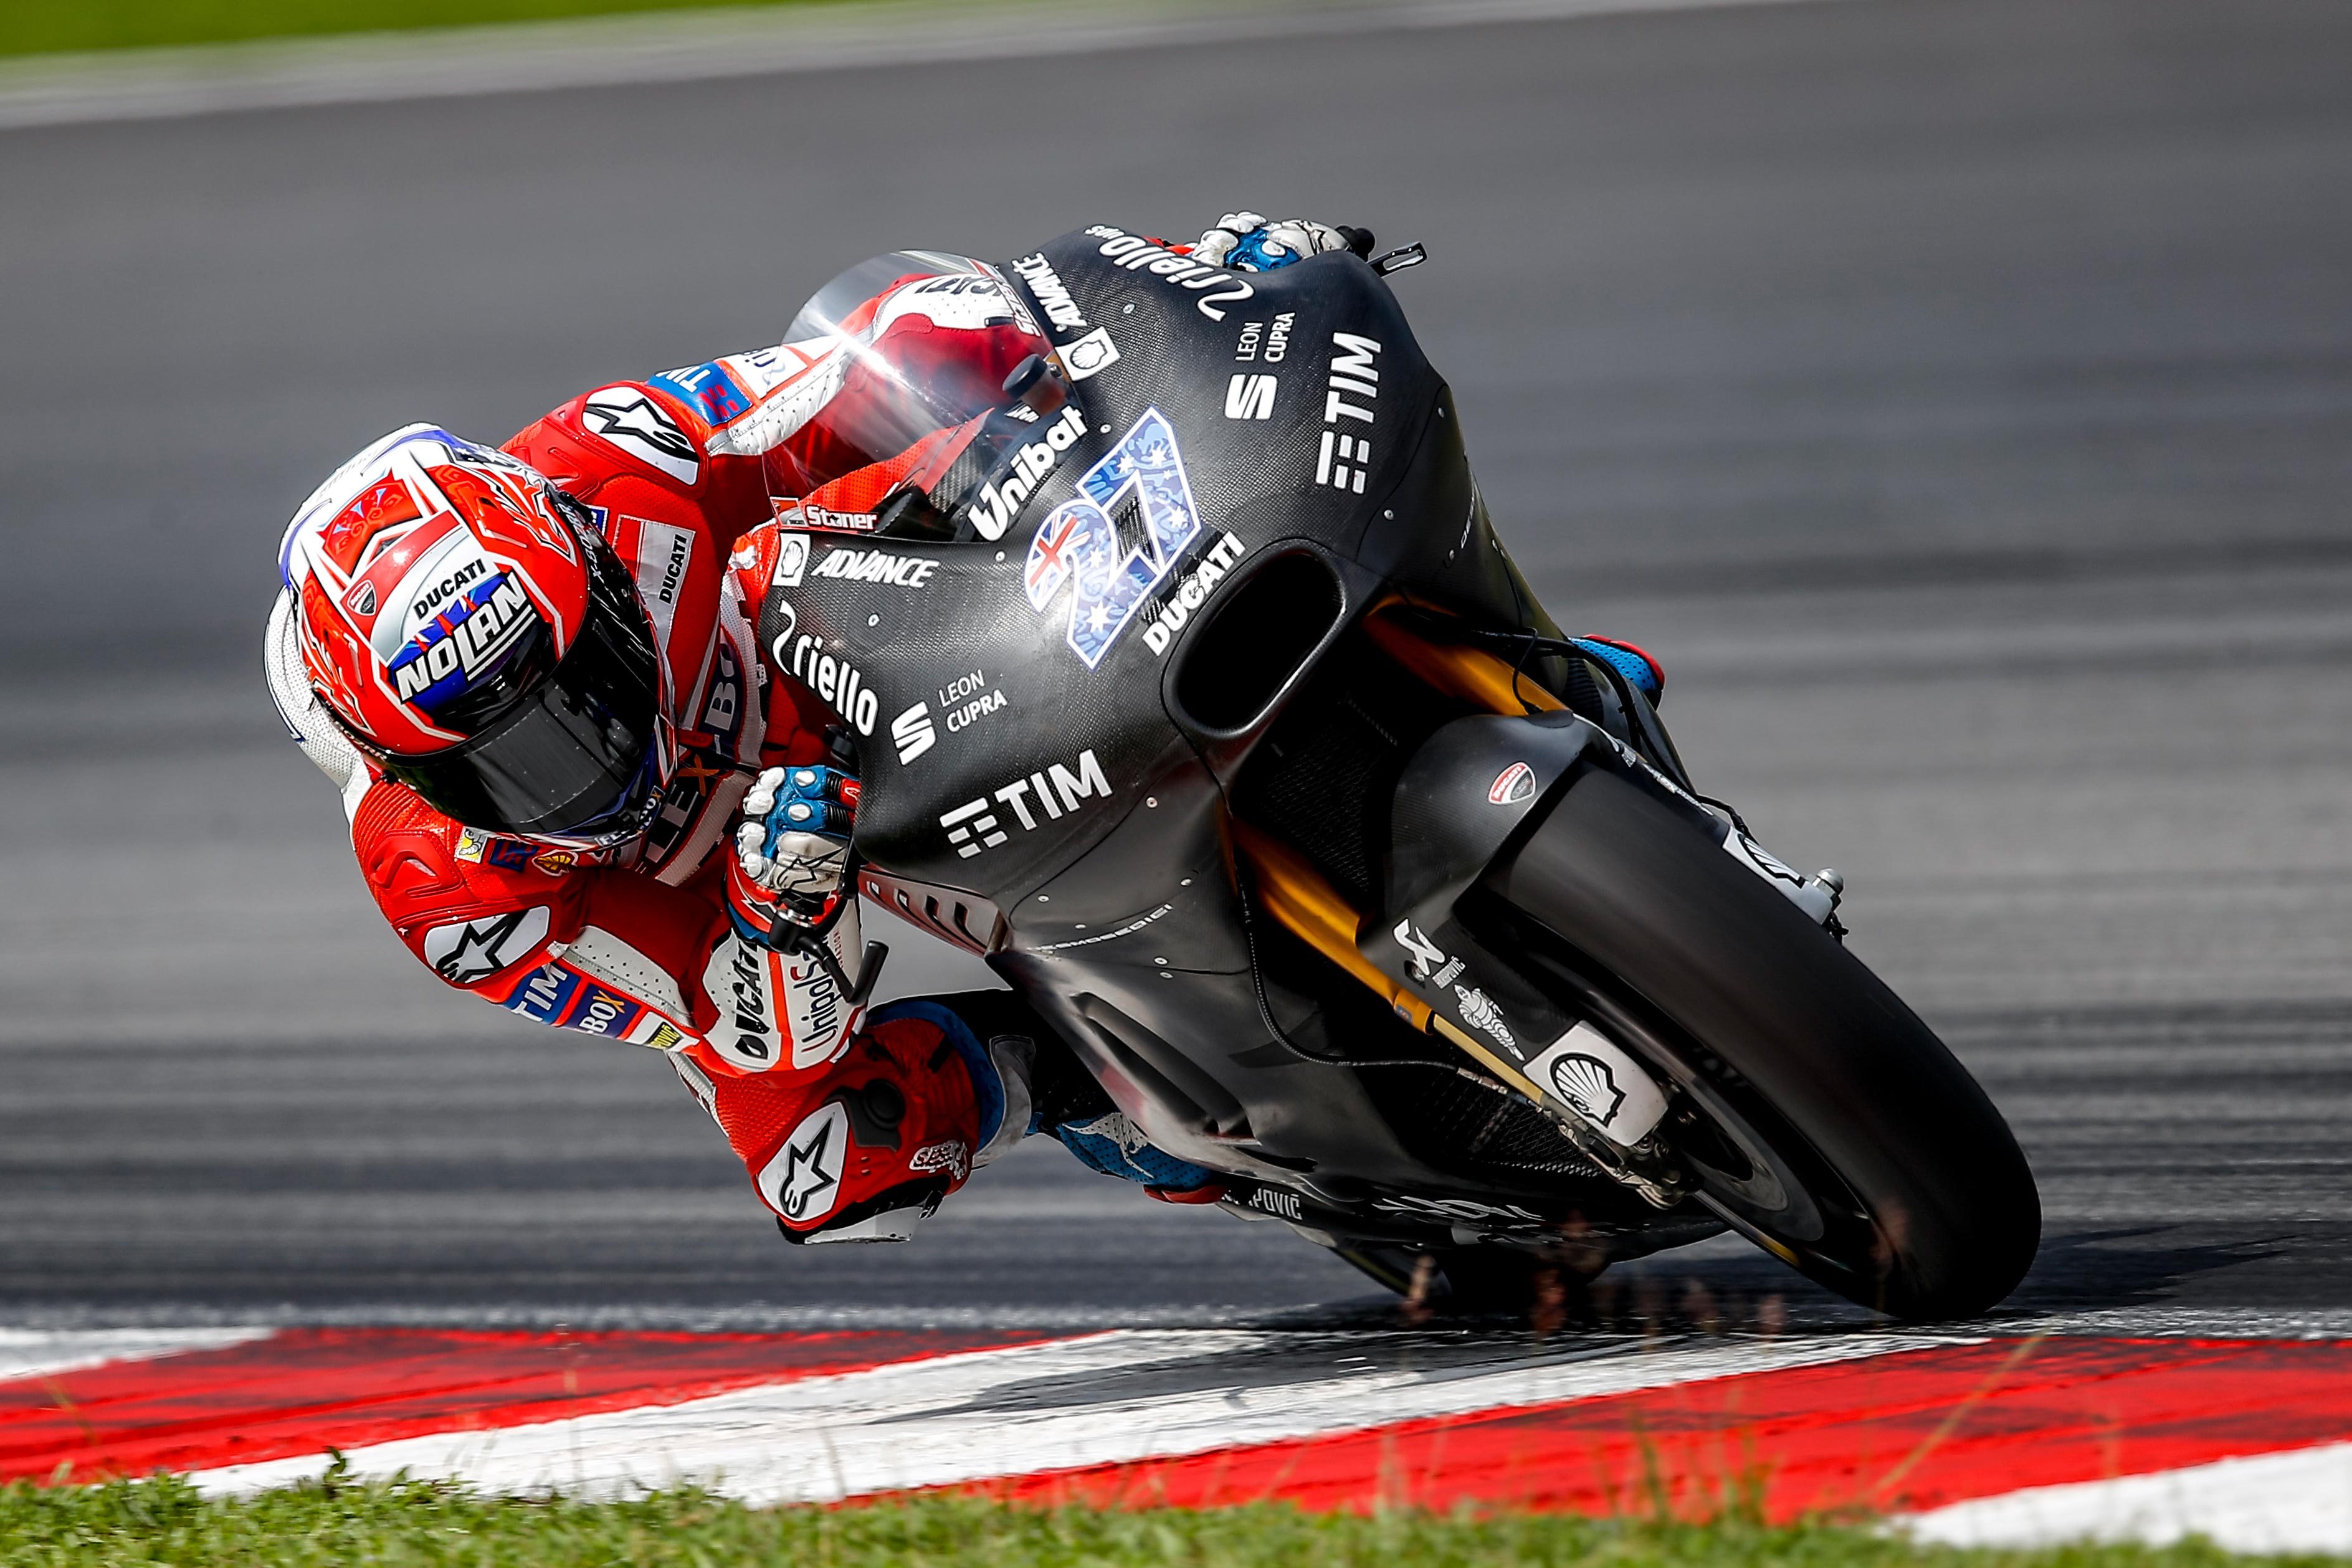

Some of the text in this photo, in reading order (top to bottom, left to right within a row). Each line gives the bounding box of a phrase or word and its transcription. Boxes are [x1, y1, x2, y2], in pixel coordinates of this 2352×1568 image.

[1011, 252, 1088, 333] ADVANCE
[1098, 235, 1233, 290] riello
[1236, 322, 1264, 362] LEON
[1264, 312, 1296, 363] CUPRA
[1325, 333, 1381, 424] TIM
[967, 405, 1088, 541] Unibat
[806, 505, 878, 530] Stoner
[1024, 404, 1203, 672] 27
[413, 558, 487, 620] DUCATI
[658, 532, 688, 604] DUCATI
[811, 548, 940, 588] ADVANCE
[1142, 531, 1245, 656] DUCATI
[395, 571, 532, 702] NOLAN
[793, 634, 879, 736] riello
[938, 669, 985, 708] LEON
[946, 689, 1008, 733] CUPRA
[997, 749, 1113, 831] TIM
[510, 963, 568, 1022] TIM
